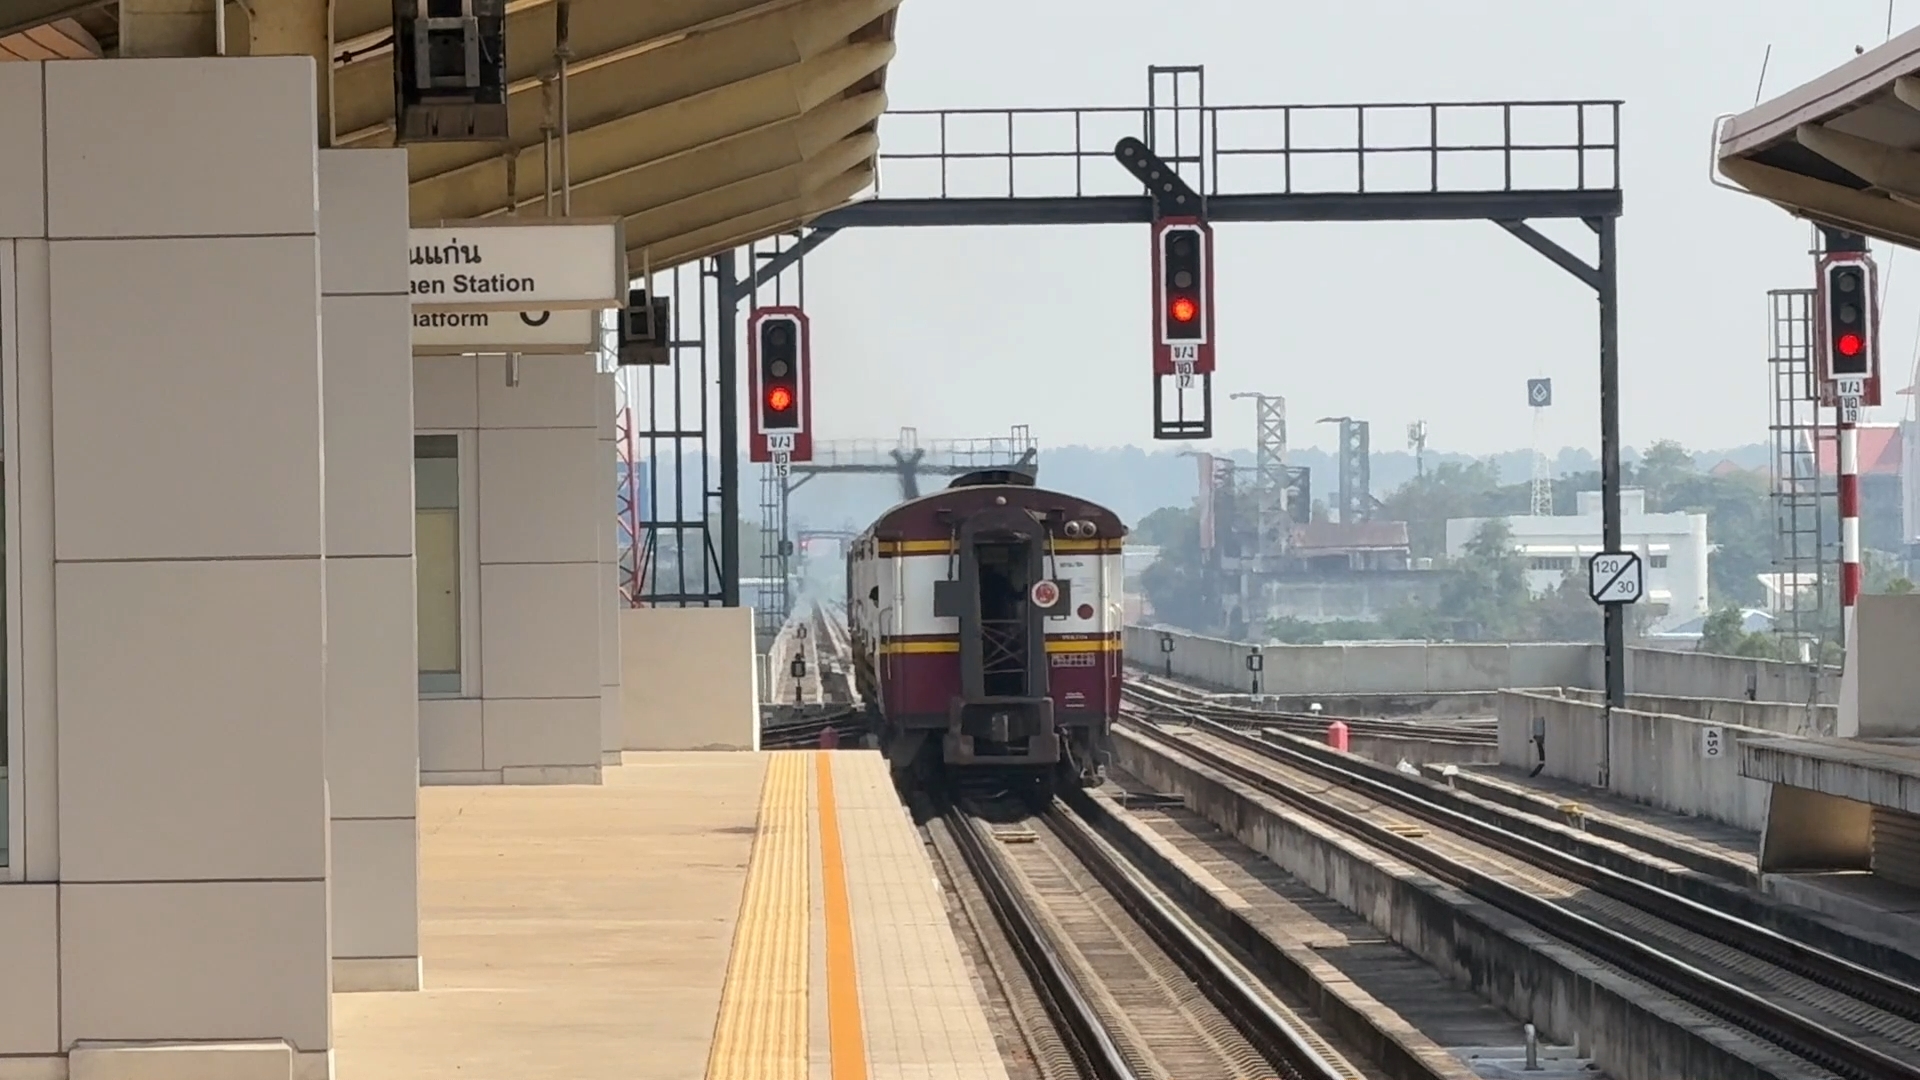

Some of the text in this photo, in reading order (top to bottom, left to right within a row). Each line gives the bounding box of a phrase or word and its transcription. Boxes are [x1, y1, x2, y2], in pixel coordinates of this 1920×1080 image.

[452, 273, 535, 294] Station
[1179, 375, 1191, 387] 17
[1846, 410, 1857, 421] 19
[776, 465, 787, 477] 15
[1594, 560, 1619, 573] 120
[1617, 580, 1635, 594] 30
[1707, 730, 1718, 756] 450
